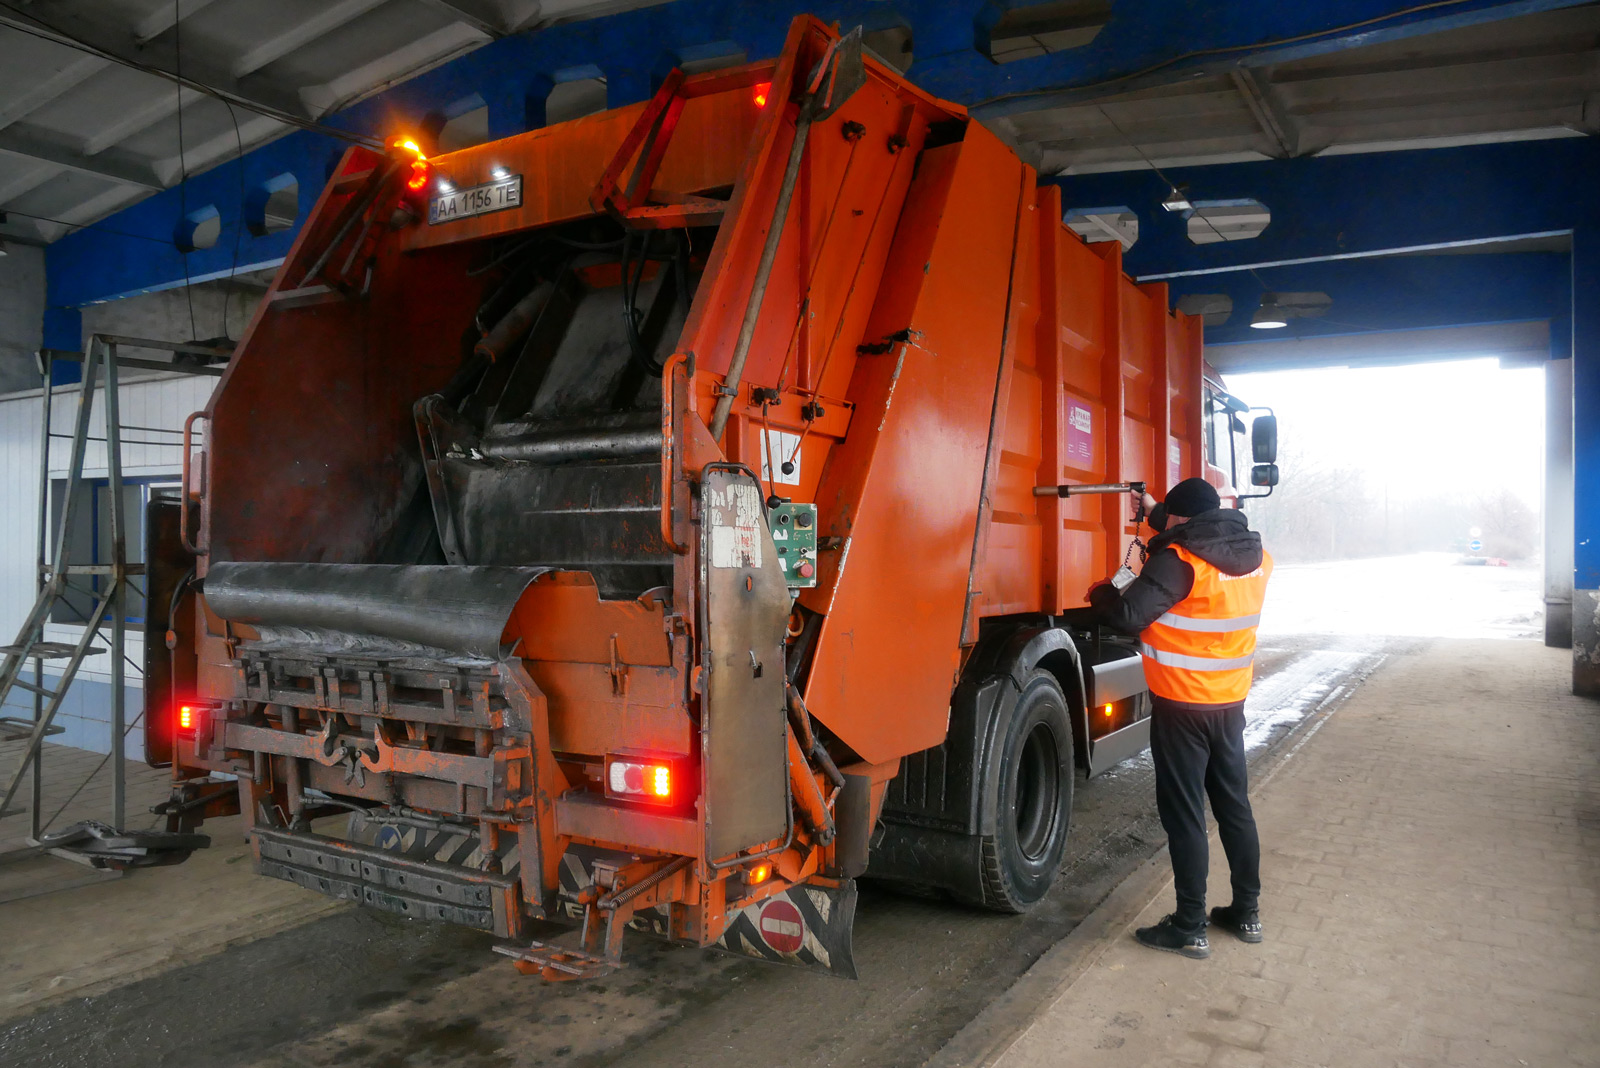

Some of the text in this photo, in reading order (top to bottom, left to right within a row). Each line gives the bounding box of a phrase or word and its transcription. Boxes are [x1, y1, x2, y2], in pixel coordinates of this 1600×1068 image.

[438, 198, 457, 217] AA
[461, 189, 492, 212] 1156
[496, 181, 516, 203] TE
